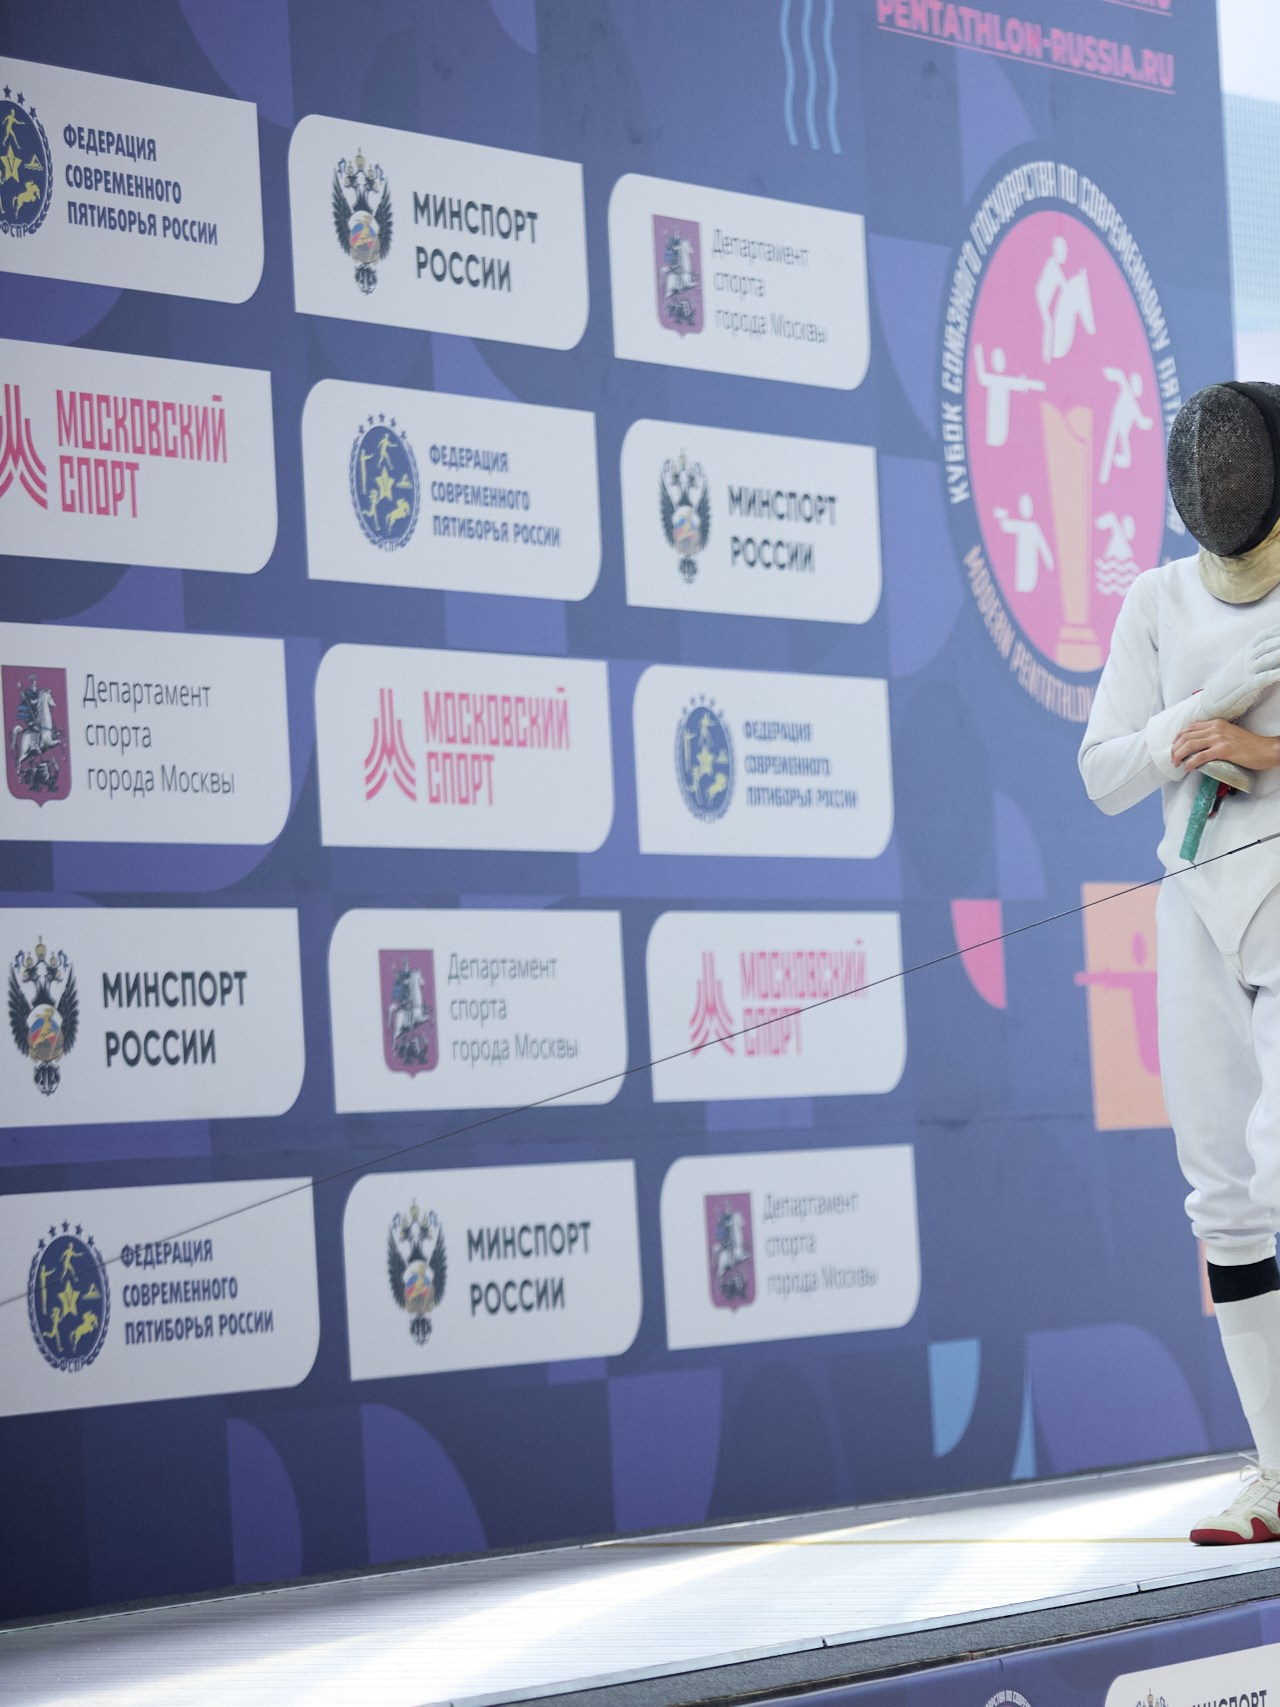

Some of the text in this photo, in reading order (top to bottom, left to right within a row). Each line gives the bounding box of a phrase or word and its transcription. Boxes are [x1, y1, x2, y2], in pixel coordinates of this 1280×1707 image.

[877, 0, 1175, 88] PENTATHLON-RUSSIA.RU
[63, 124, 157, 162] ФЕДЕРАЦИЯ
[65, 164, 182, 204] СОВРЕМЕННОГО
[67, 201, 218, 245] ПЯТИБОРЬЯ РОССИИ
[412, 191, 538, 244] МИНСПОРТ
[711, 229, 810, 267] Департамент
[416, 246, 512, 293] РОССИИ
[714, 272, 766, 302] спорта
[716, 310, 829, 344] города Москвы
[942, 401, 970, 504] КУБОК
[1056, 163, 1078, 204] ПО
[56, 389, 228, 464] МОСКОВСКИЙ
[429, 444, 509, 473] ФЕДЕРАЦИЯ
[59, 455, 140, 518] СПОРТ
[430, 481, 530, 511] СОВРЕМЕННОГО
[728, 485, 837, 526] МИНСПОРТ
[432, 515, 561, 548] ПЯТИБОРЬЯ РОССИИ
[730, 535, 815, 573] РОССИИ
[83, 674, 211, 712] Департамент
[424, 686, 570, 750] МОСКОВСКИЙ
[85, 724, 152, 756] спорта
[88, 765, 235, 798] города Москвы
[426, 751, 495, 806] СПОРТ
[102, 970, 247, 1008] МИНСПОРТ
[448, 953, 557, 987] Департамент
[450, 997, 507, 1031] спорта
[105, 1029, 216, 1067] РОССИИ
[452, 1033, 578, 1068] города Москвы
[121, 1239, 213, 1269] ФЕДЕРАЦИЯ
[466, 1221, 591, 1262] МИНСПОРТ
[122, 1277, 238, 1308] СОВРЕМЕННОГО
[470, 1276, 566, 1318] РОССИИ
[125, 1310, 274, 1346] ПЯТИБОРЬЯ РОССИИ
